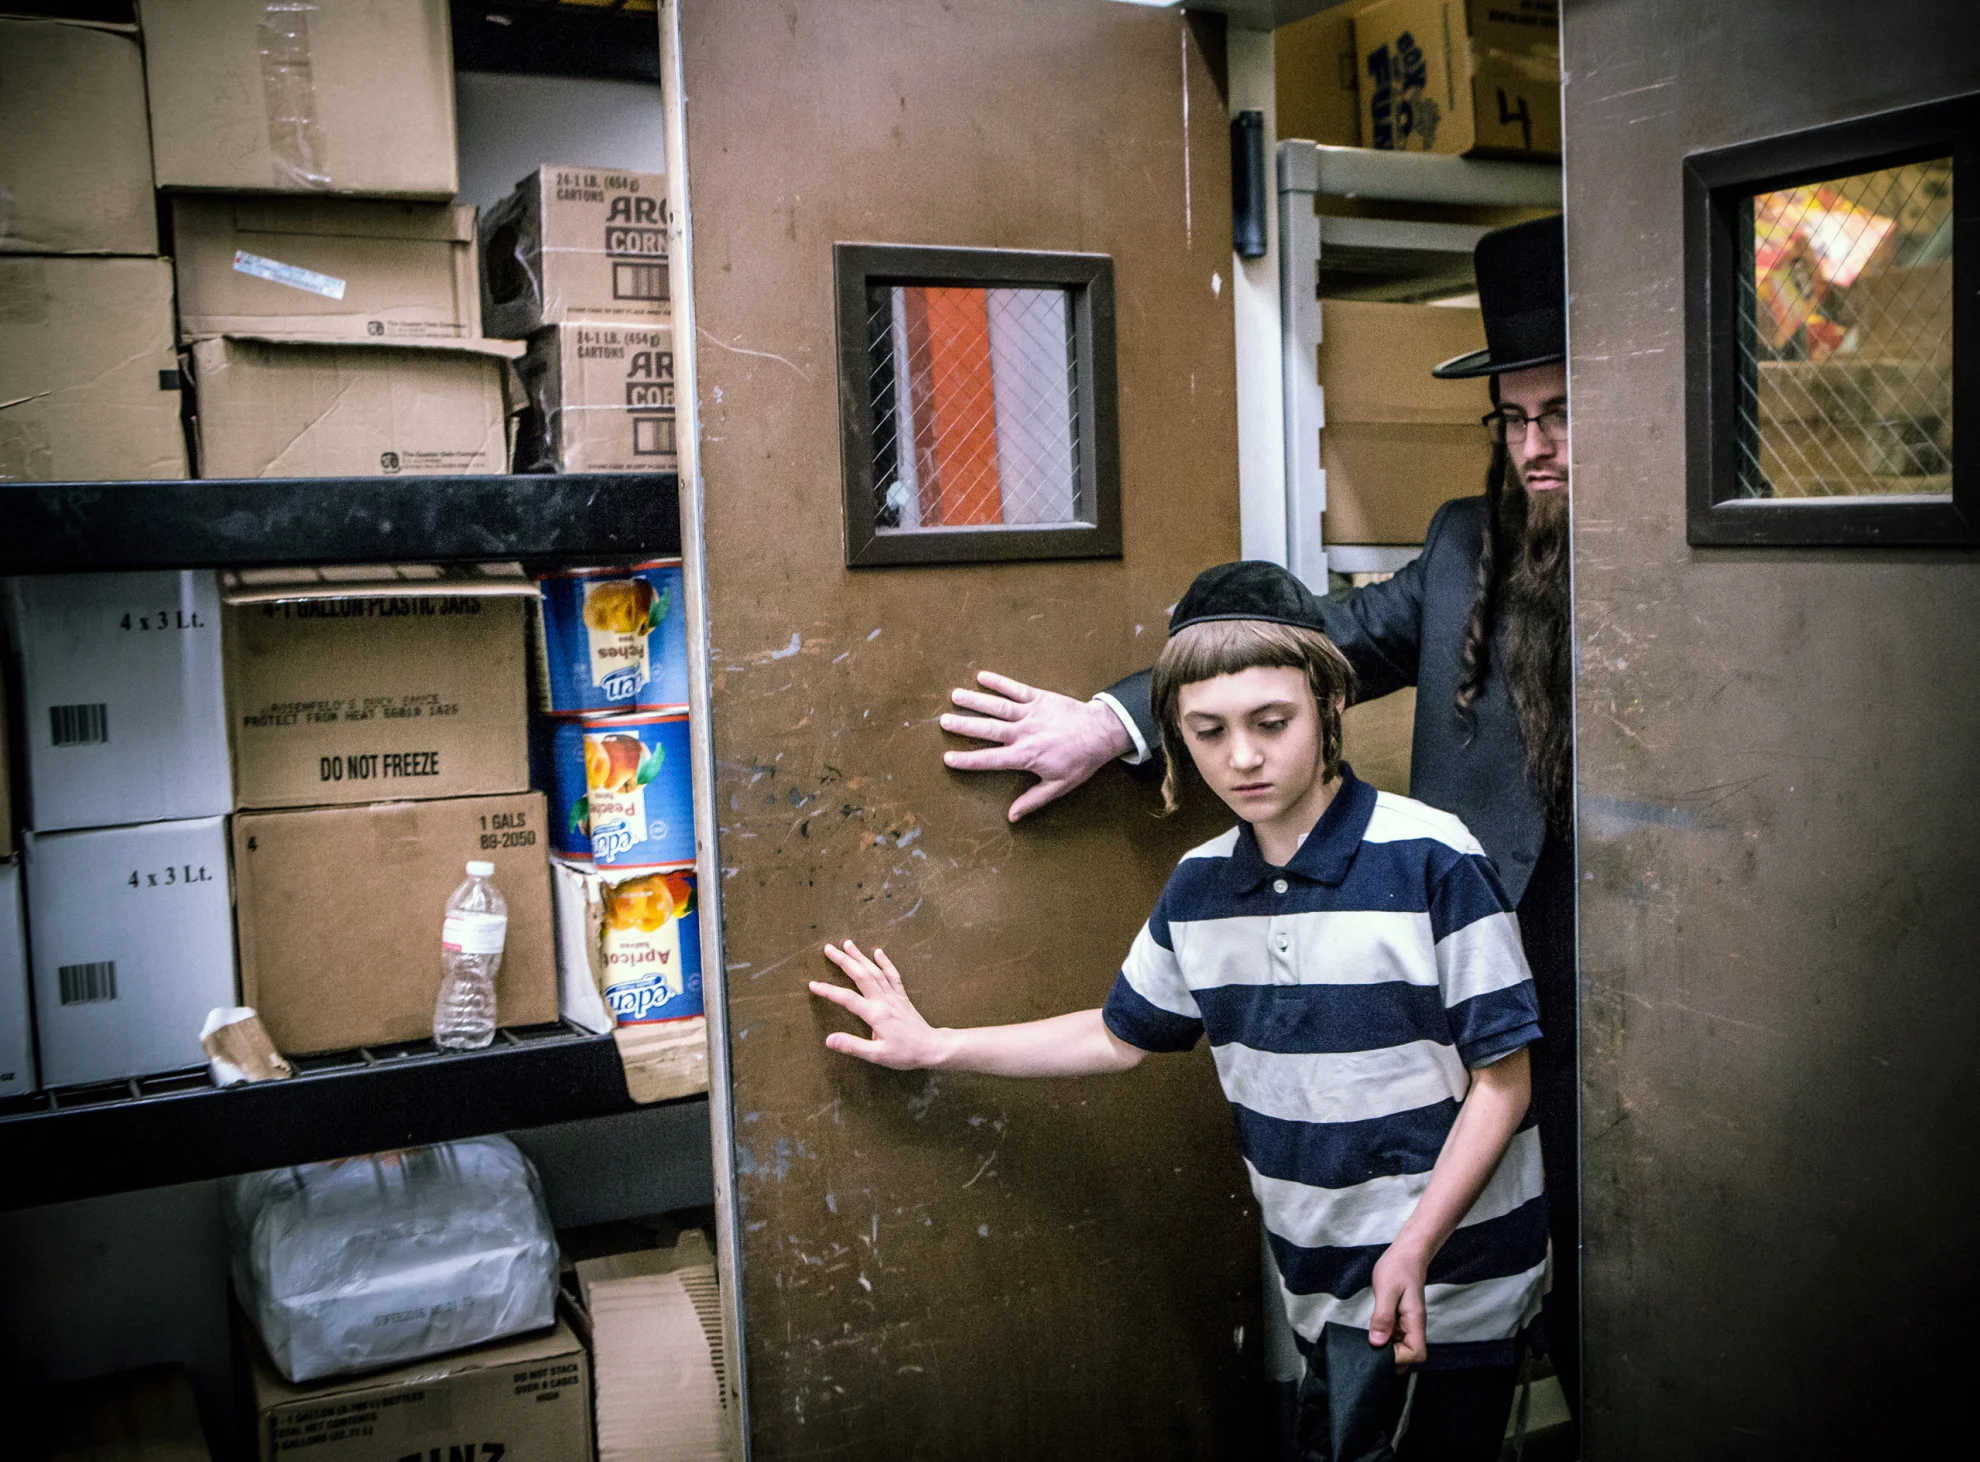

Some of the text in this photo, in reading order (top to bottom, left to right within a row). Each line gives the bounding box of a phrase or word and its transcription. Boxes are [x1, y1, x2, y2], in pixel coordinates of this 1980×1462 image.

[1496, 88, 1531, 151] 4
[556, 188, 605, 203] CARTONS
[576, 331, 600, 344] 24-1
[604, 332, 621, 344] LB.
[577, 346, 625, 359] CARTONS
[297, 598, 364, 618] GALLON
[369, 597, 436, 617] PLASTIC
[120, 610, 205, 631] 4 x 3 Lt.
[320, 751, 440, 781] DO NOT FREEZE
[479, 812, 526, 831] 1 GALS
[248, 836, 258, 852] 4
[480, 830, 537, 850] 89-2050
[127, 864, 213, 889] 4 x 3 Lt.
[514, 1363, 578, 1382] DO NOT STACK
[515, 1382, 539, 1395] OVER
[550, 1375, 579, 1389] CASES
[295, 1407, 336, 1422] GALLON
[383, 1390, 425, 1407] BOTTLES
[305, 1420, 325, 1433] NET
[327, 1411, 378, 1428] CONTENTS
